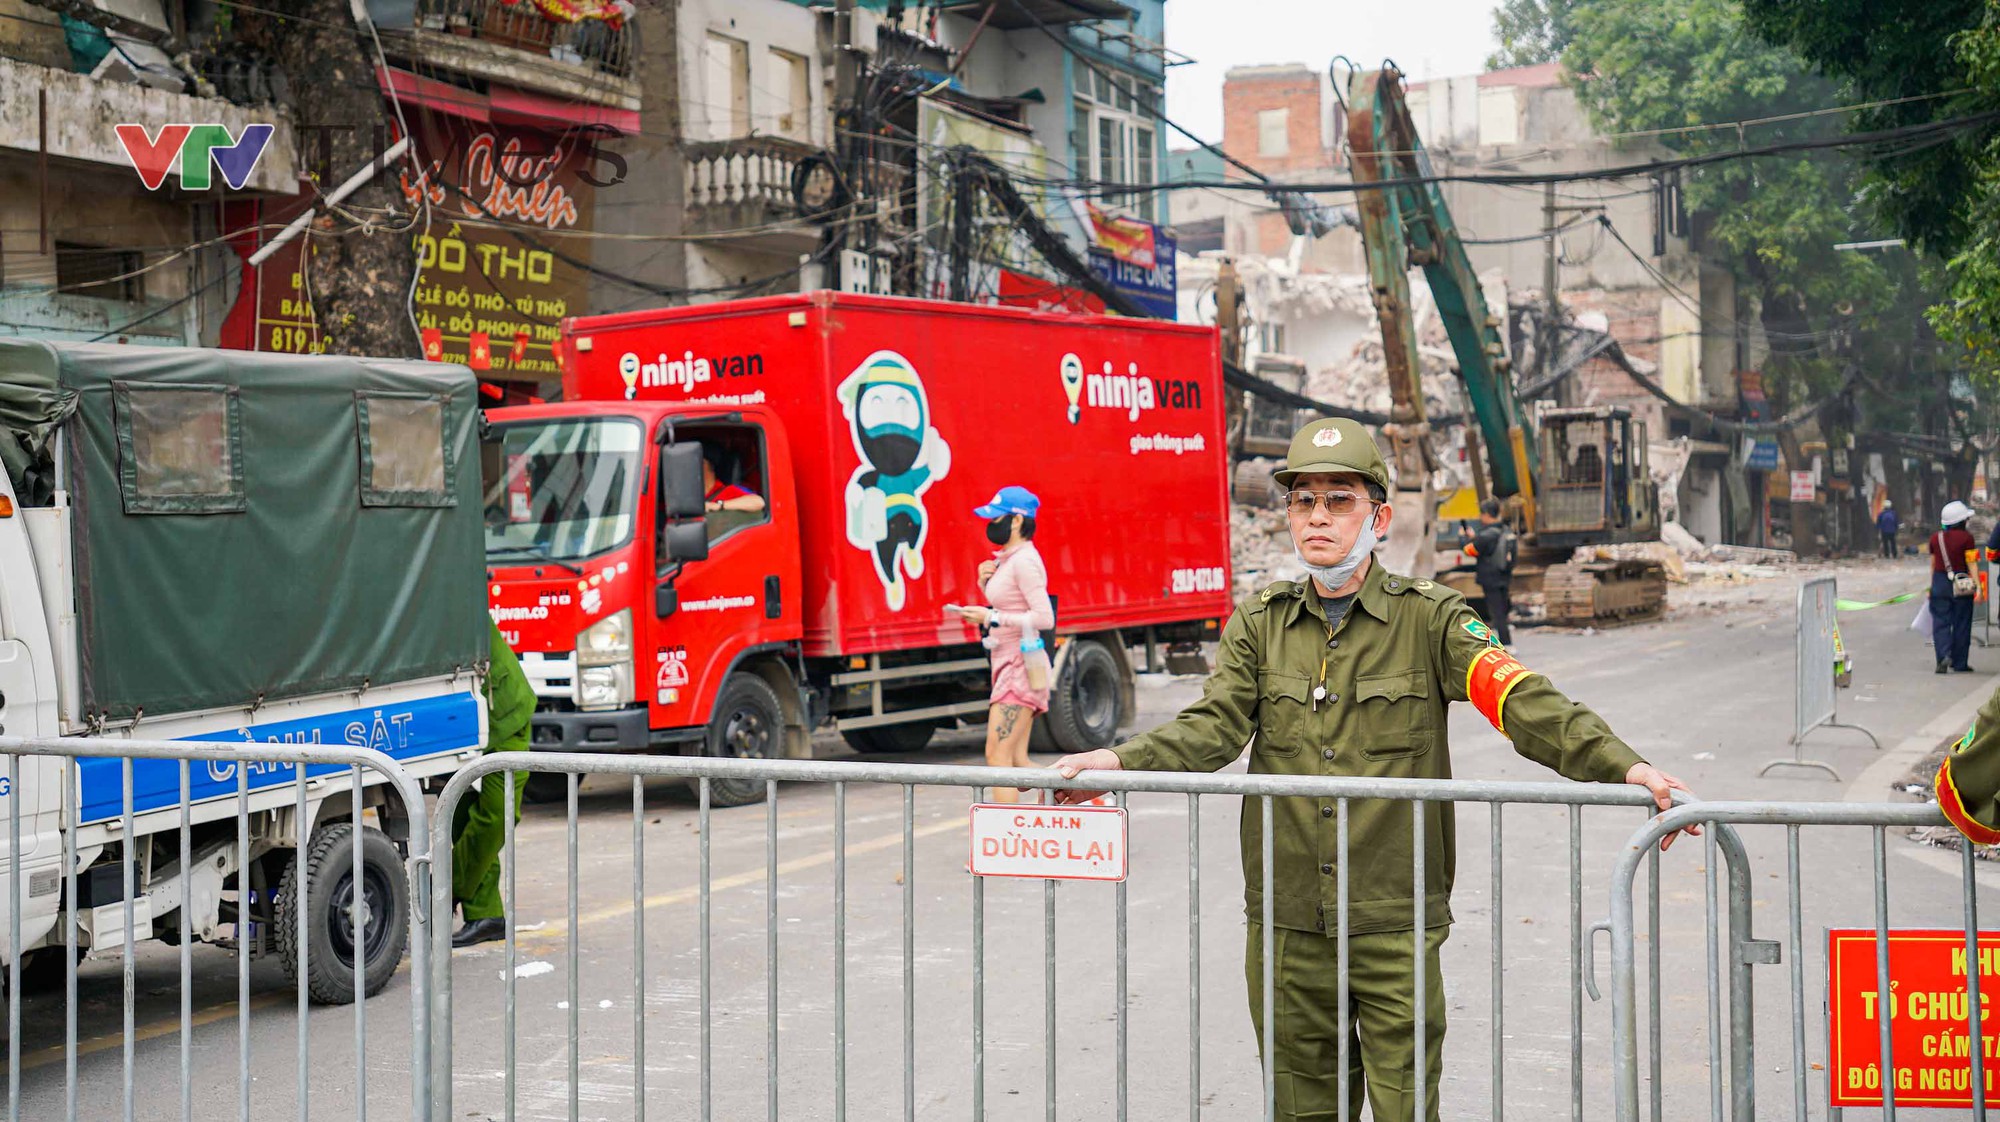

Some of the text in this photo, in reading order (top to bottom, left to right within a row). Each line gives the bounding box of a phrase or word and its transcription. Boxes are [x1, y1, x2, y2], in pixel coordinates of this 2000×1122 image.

[271, 327, 307, 351] 819
[1014, 816, 1081, 829] C.A.H.N
[982, 831, 1113, 866] DỪNG LẠI
[1848, 1063, 1993, 1091] ĐÔG NGƯI
